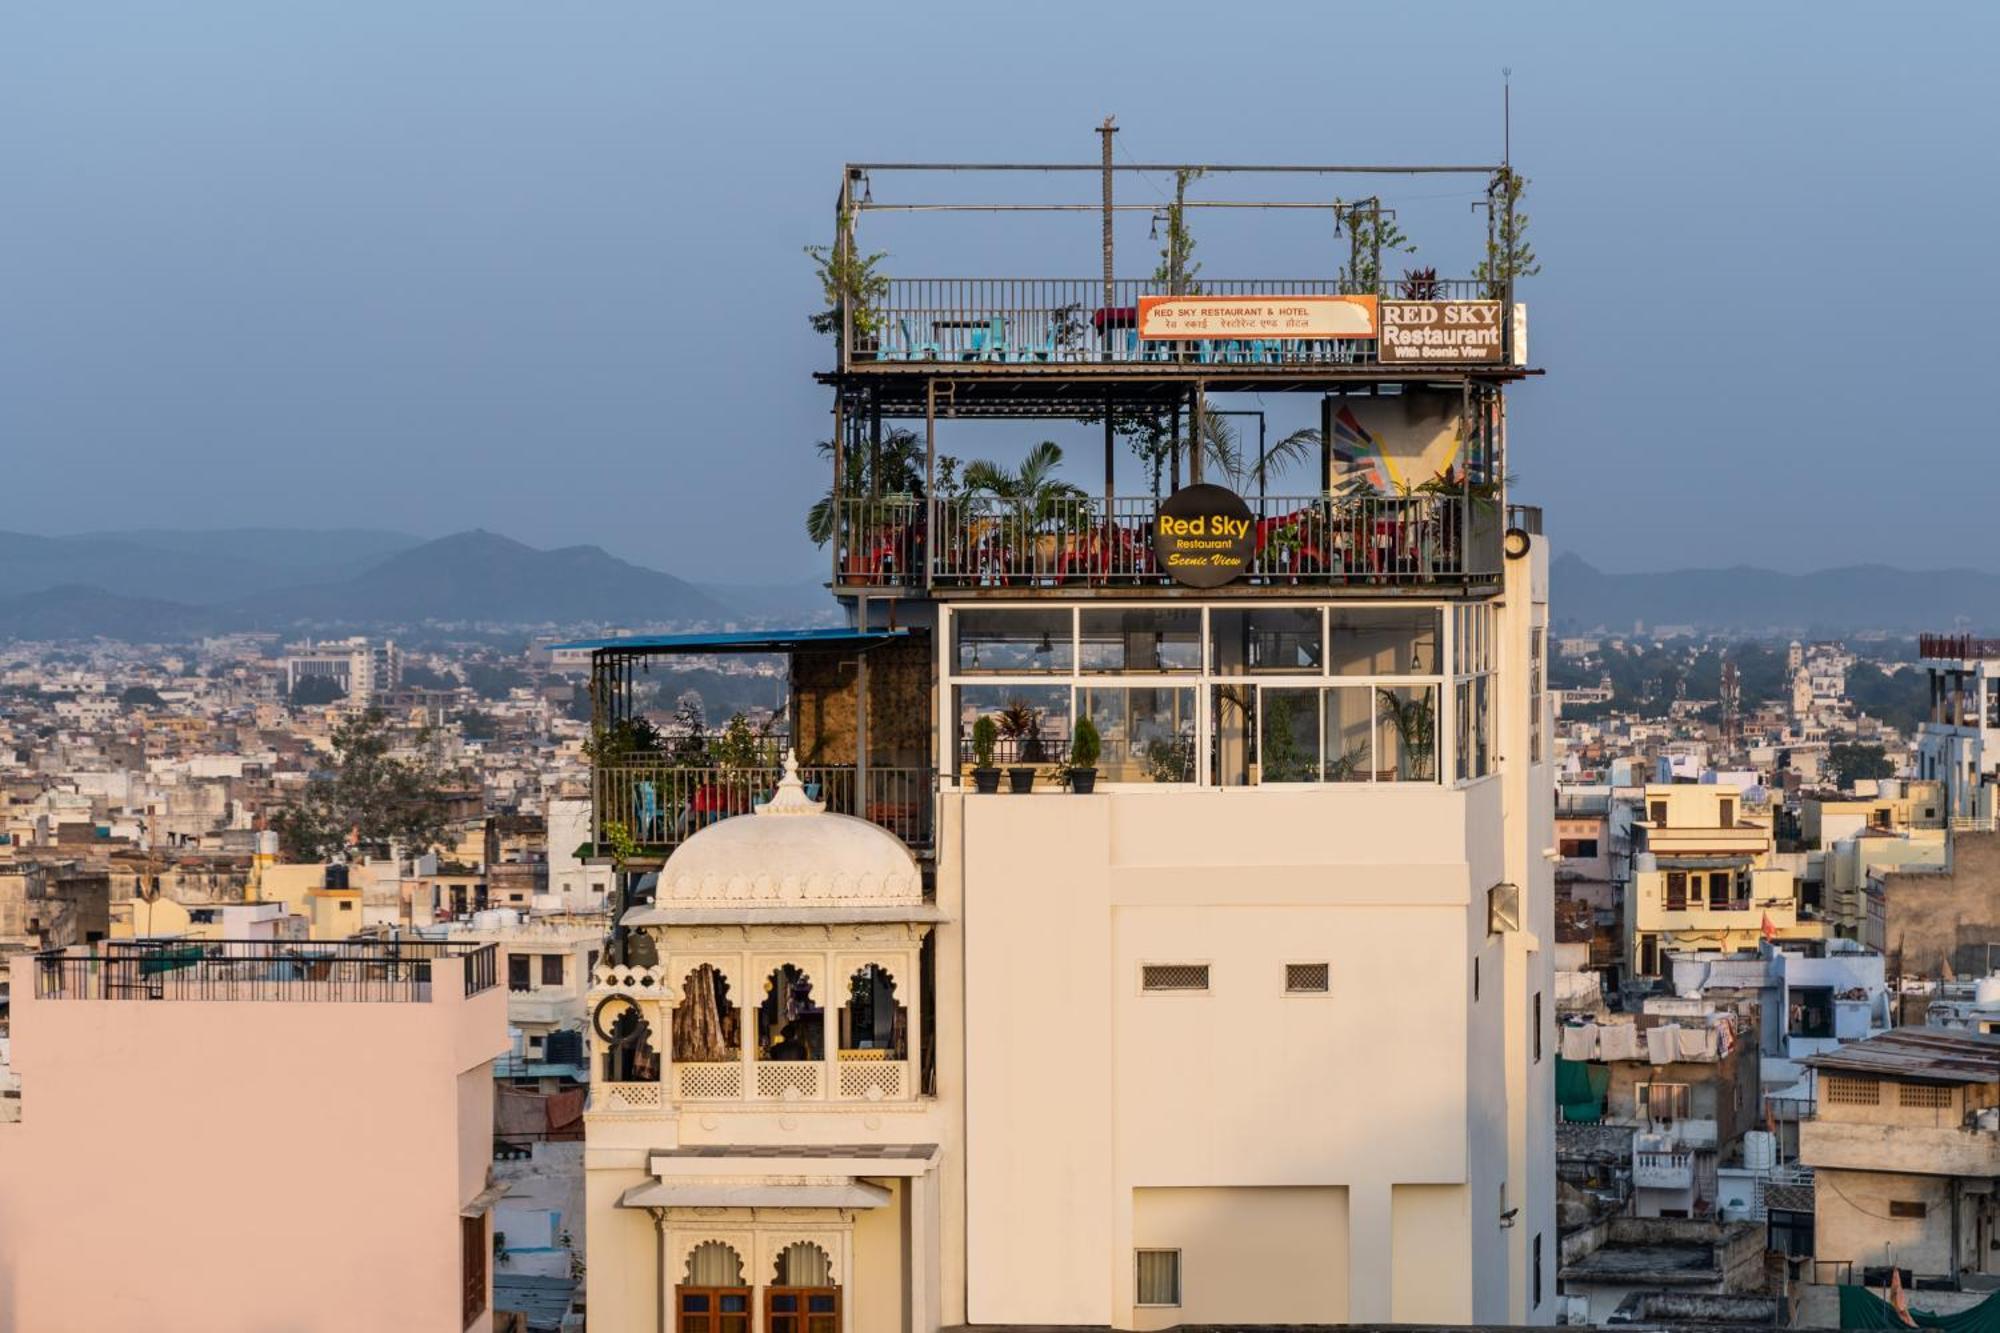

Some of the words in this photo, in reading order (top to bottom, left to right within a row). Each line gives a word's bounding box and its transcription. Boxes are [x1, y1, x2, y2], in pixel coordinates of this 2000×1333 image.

[1154, 308, 1173, 317] RED
[1178, 308, 1197, 317] SKY
[1201, 308, 1262, 316] RESTAURANT
[1267, 308, 1274, 316] &
[1280, 307, 1309, 316] HOTEL
[1382, 306, 1438, 324] RED
[1445, 306, 1499, 324] SKY
[1383, 326, 1499, 345] Restaurant
[1395, 346, 1420, 358] With
[1422, 346, 1459, 358] Scenic
[1460, 346, 1487, 358] View
[1160, 515, 1205, 535] Red
[1211, 515, 1250, 539] Sky
[1177, 540, 1232, 549] Restaurant
[1168, 553, 1207, 566] Scenic
[1210, 554, 1241, 566] View
